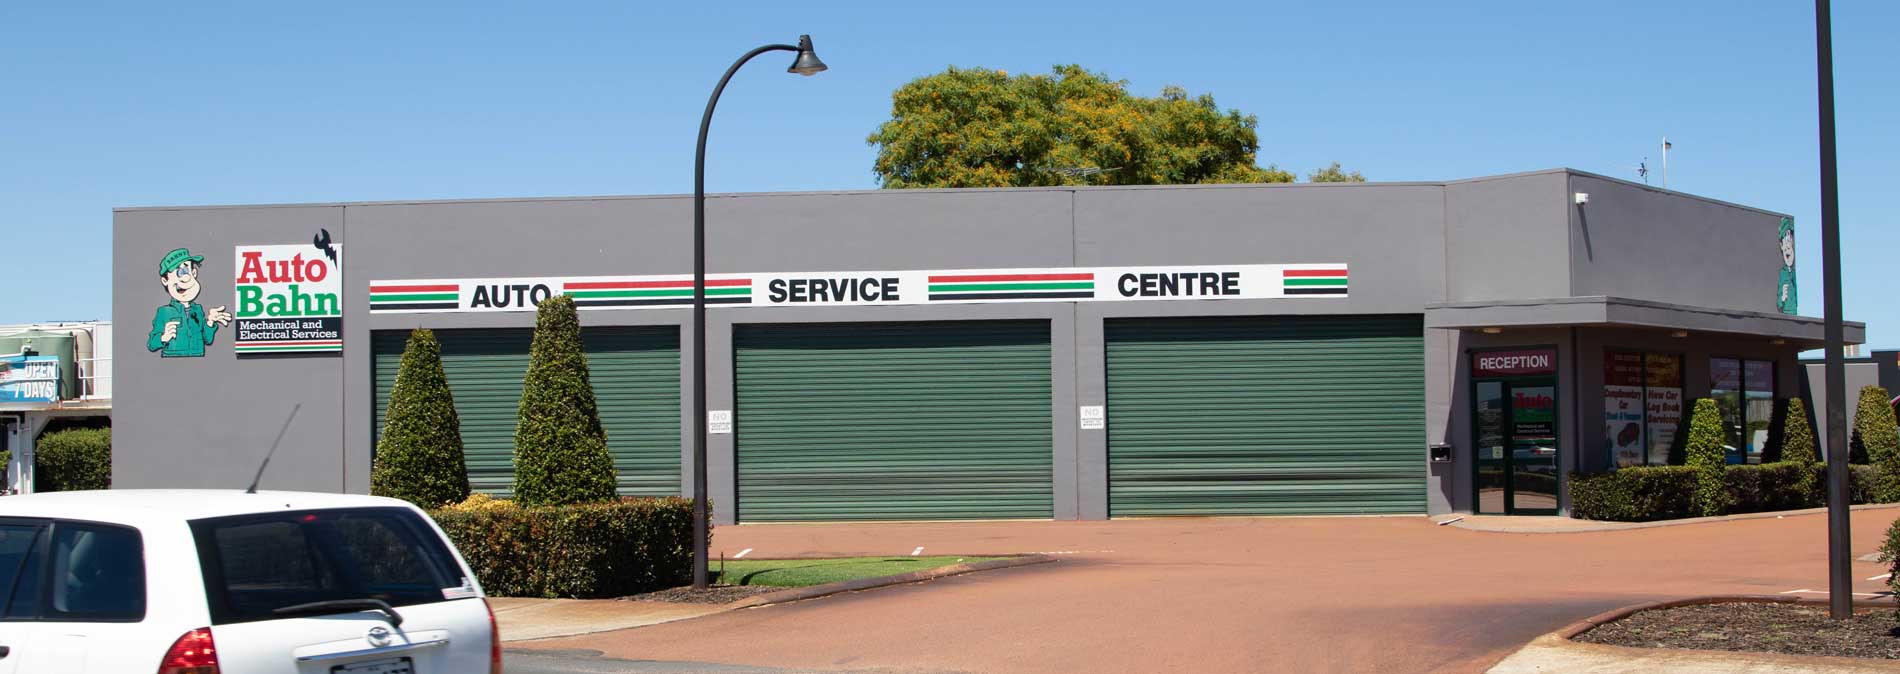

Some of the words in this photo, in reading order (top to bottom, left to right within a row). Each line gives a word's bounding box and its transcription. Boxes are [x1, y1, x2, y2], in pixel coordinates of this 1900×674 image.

[237, 252, 327, 283] Auto
[470, 283, 552, 308] AUTO
[768, 277, 900, 303] SERVICE
[1117, 271, 1241, 298] CENTRE
[237, 285, 341, 317] Bahn
[240, 320, 300, 330] Mechanical
[302, 320, 322, 329] and
[240, 330, 290, 340] Electrical
[291, 329, 338, 338] Services
[25, 361, 56, 378] OPEN
[1480, 354, 1549, 370] RECEPTION
[24, 381, 54, 399] DAYS
[1665, 391, 1679, 400] Car
